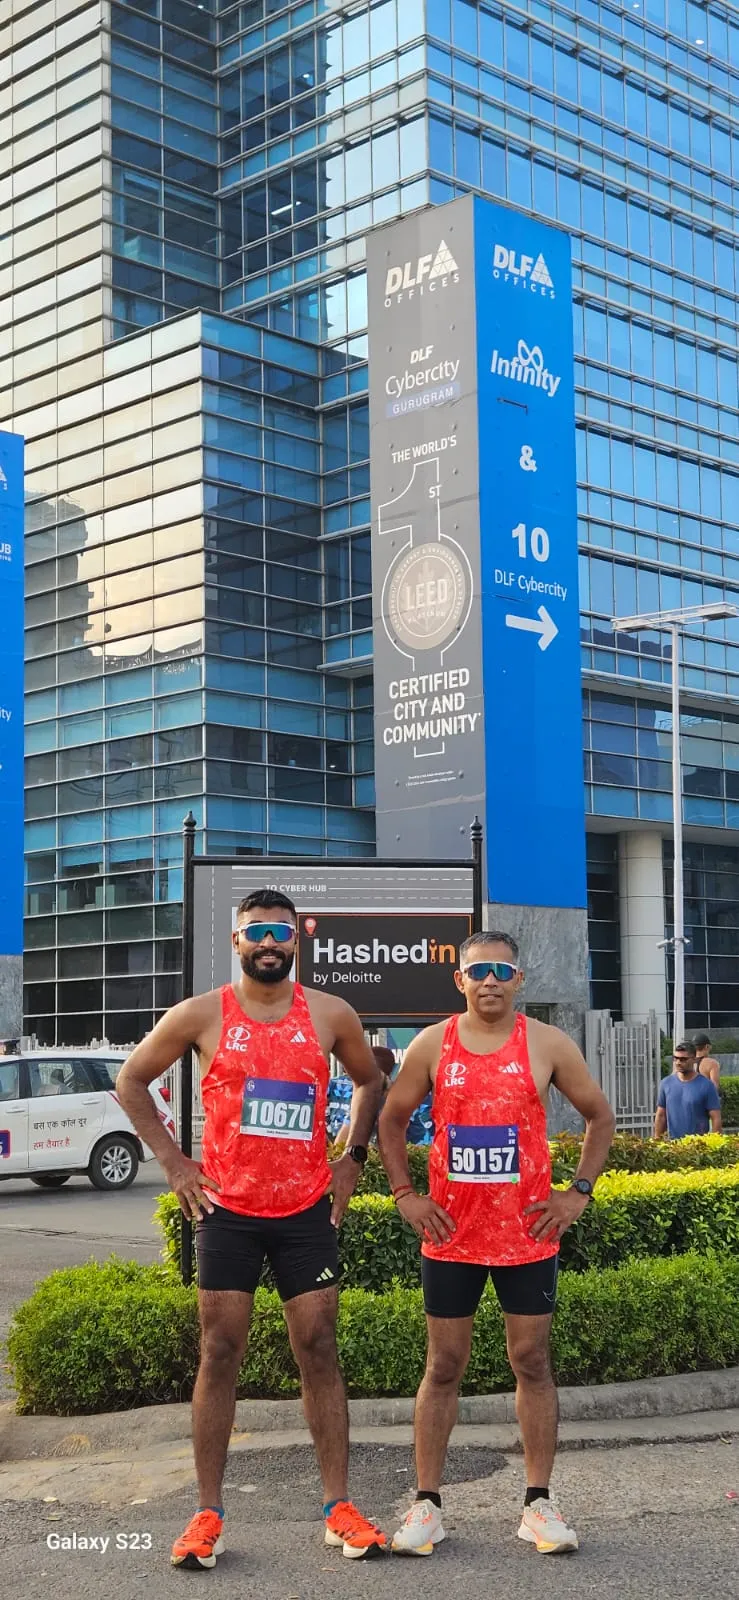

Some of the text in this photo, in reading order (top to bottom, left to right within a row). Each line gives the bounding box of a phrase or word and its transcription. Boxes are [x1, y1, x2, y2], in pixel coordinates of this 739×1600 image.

[385, 253, 433, 296] DLF
[493, 243, 534, 278] DLF
[384, 273, 460, 308] OFFICES
[492, 269, 556, 300] OFFICES
[410, 345, 434, 364] DLF
[385, 359, 460, 398] Cybercity
[490, 349, 561, 398] Infinity
[392, 386, 454, 415] GURUGRAM
[391, 435, 457, 464] THE WORLD'S
[519, 444, 538, 473] &
[428, 484, 443, 500] ST
[511, 523, 550, 563] 10
[405, 578, 448, 611] LEED
[494, 569, 568, 601] DLF Cybercity
[388, 667, 470, 699] CERTIFIED
[394, 692, 465, 721] CITY AND
[265, 884, 327, 892] TO CYBER HUB
[313, 938, 456, 964] Hashedin
[313, 970, 382, 984] by Deloitte
[225, 1041, 248, 1052] LRC
[444, 1077, 466, 1087] LRC
[248, 1100, 312, 1130] 10670
[451, 1146, 516, 1173] 50157
